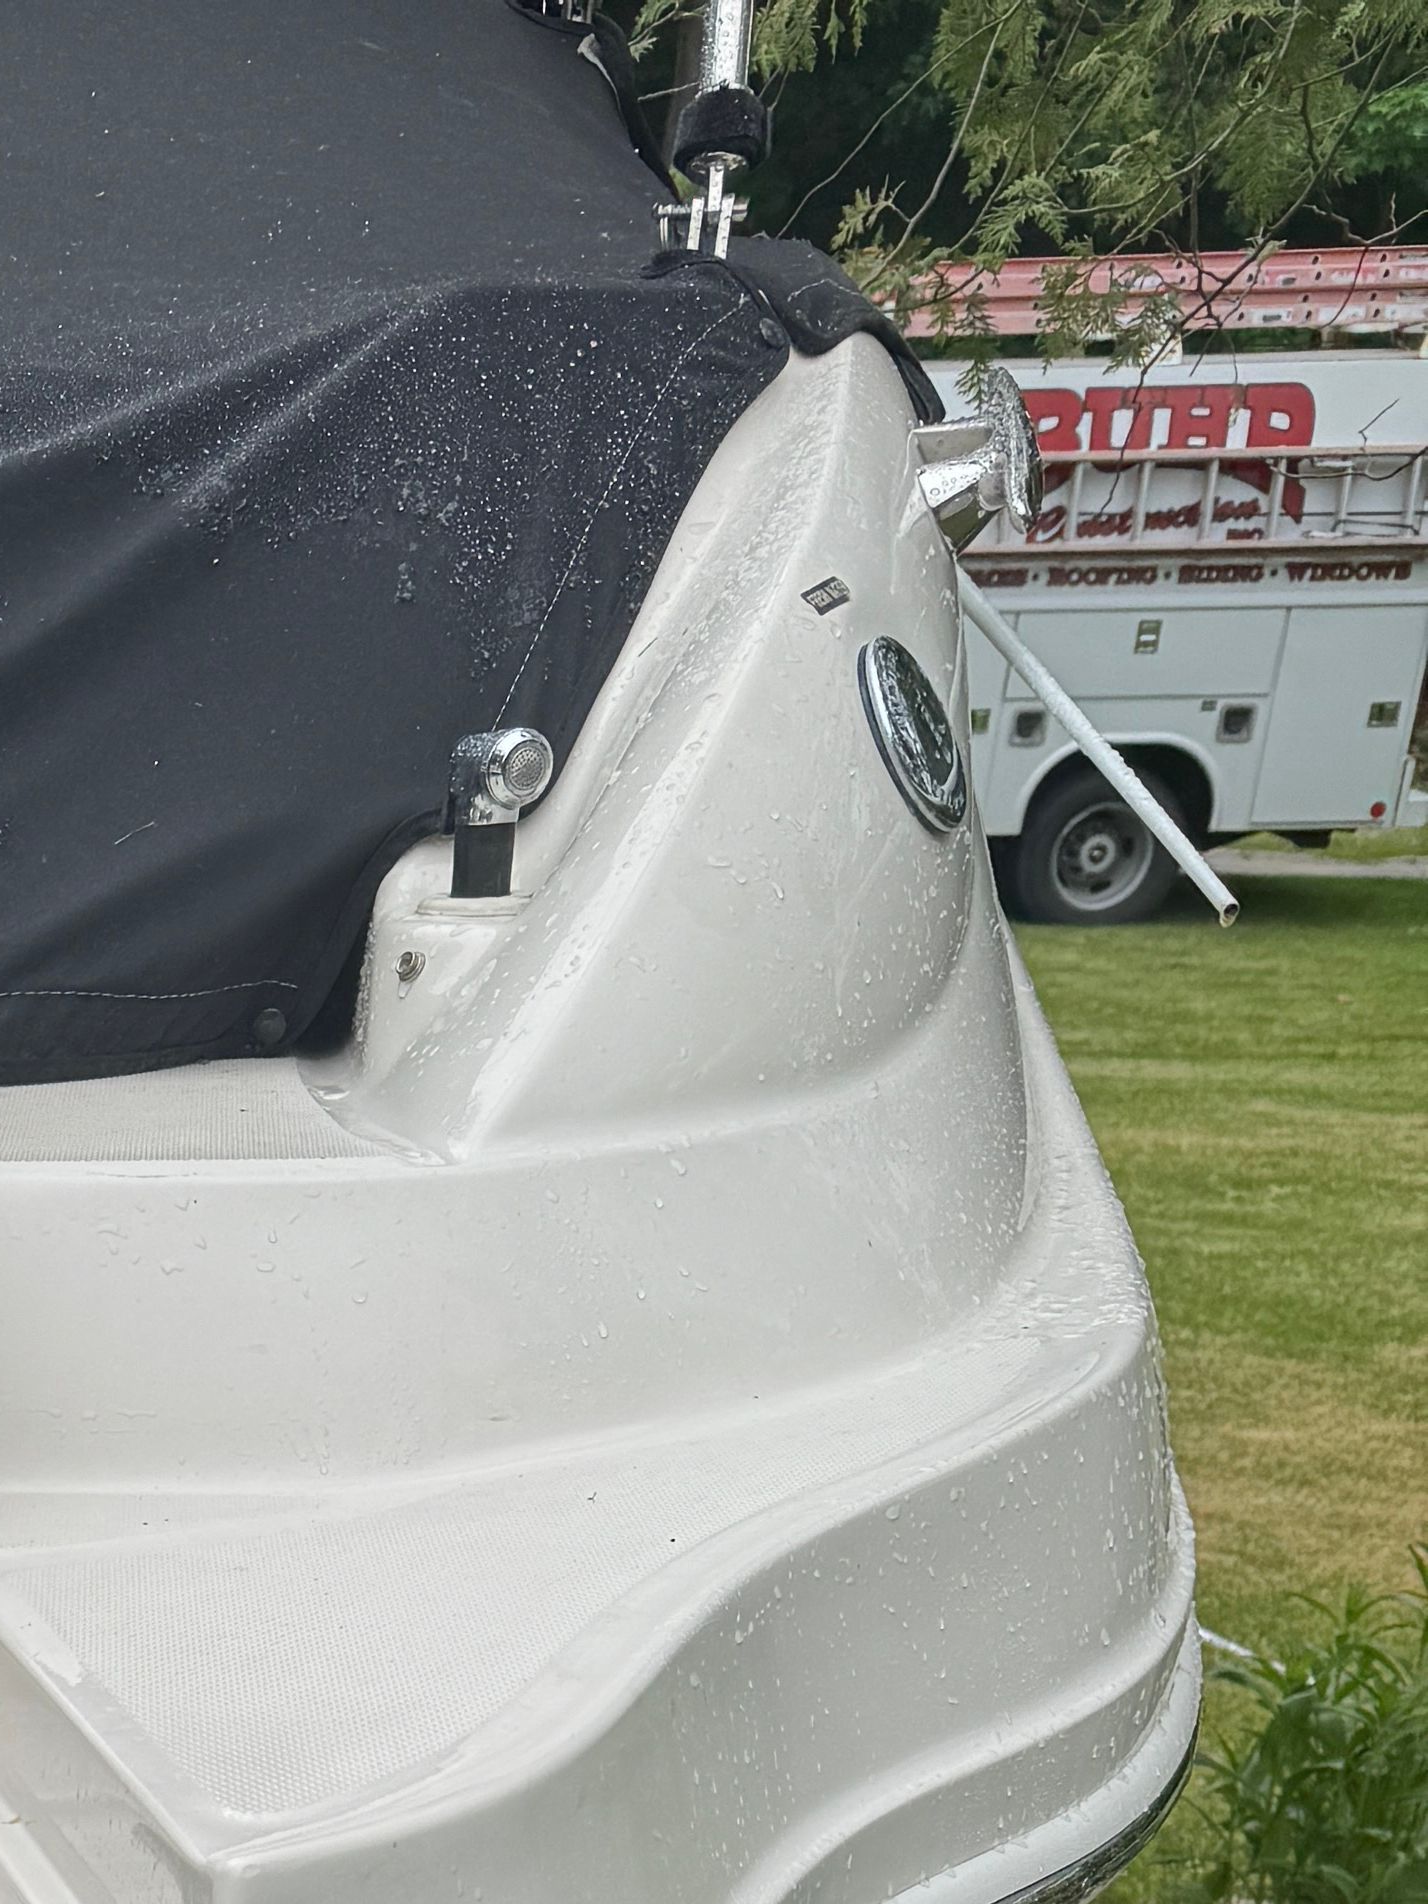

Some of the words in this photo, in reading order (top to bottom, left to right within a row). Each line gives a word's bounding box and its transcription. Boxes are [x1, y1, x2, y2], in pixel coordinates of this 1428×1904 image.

[1047, 566, 1158, 587] ROOFING
[1178, 564, 1264, 584] SIDING
[1285, 561, 1412, 582] WINDOWS
